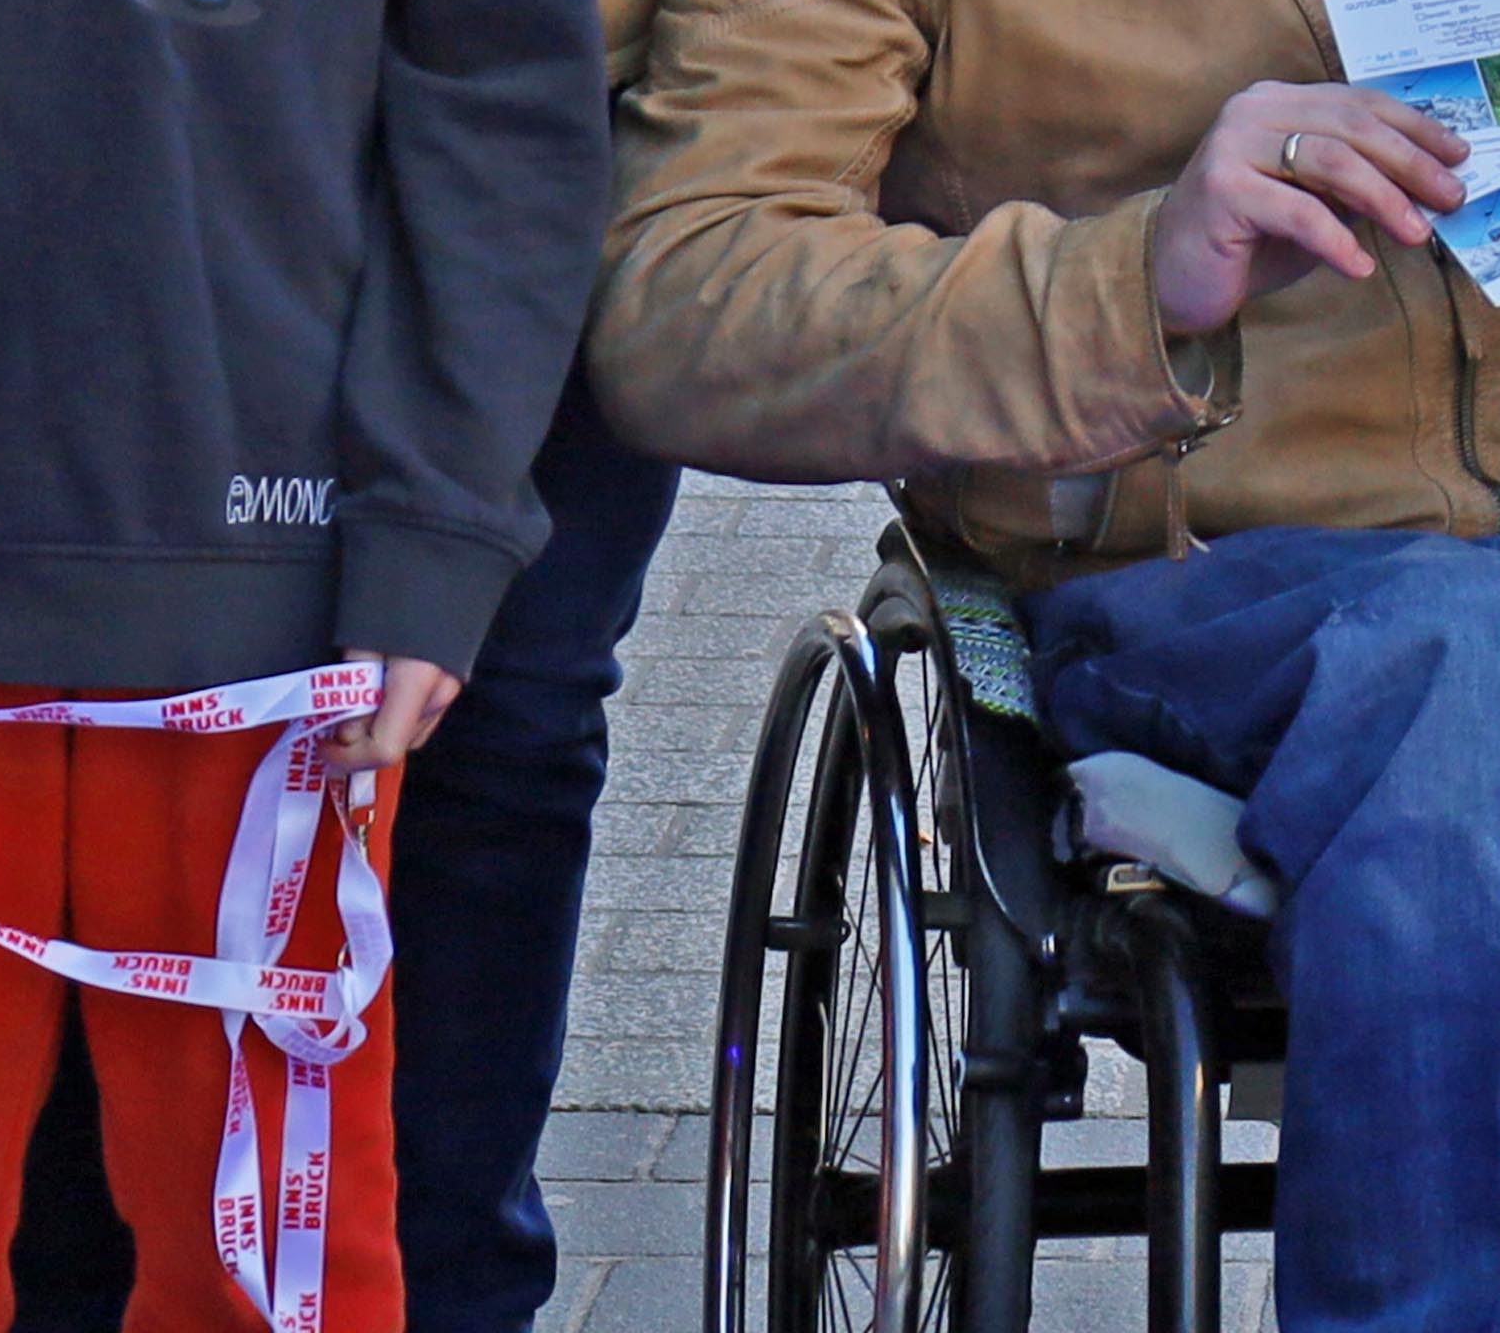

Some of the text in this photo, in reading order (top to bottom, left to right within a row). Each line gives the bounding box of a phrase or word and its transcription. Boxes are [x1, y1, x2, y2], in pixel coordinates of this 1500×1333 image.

[310, 668, 373, 691] INNS'
[160, 692, 224, 718] INNS'
[111, 955, 192, 975] BRUCK
[123, 974, 190, 996] INNS'
[258, 970, 327, 994] BRUCK
[269, 993, 325, 1014] INNS'
[283, 1167, 304, 1230] INNS'
[303, 1151, 326, 1230] BRUCK
[237, 1194, 257, 1255] INNS'
